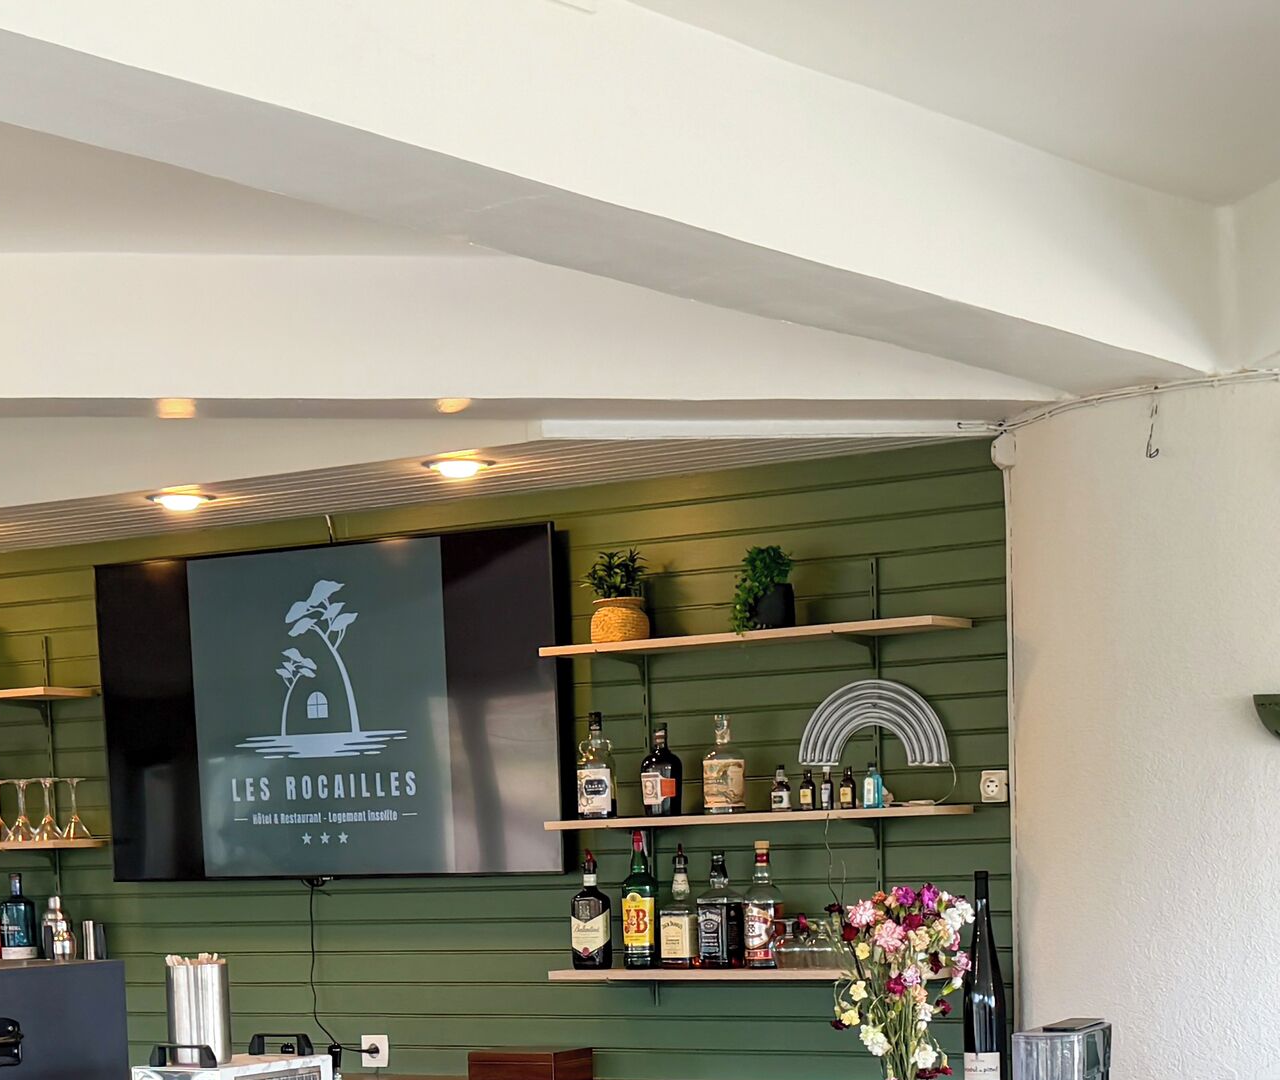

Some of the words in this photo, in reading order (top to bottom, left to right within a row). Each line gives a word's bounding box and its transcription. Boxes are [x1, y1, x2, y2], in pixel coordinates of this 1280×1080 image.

[231, 777, 270, 802] LES
[285, 770, 417, 800] ROCAILLES
[252, 812, 272, 825] Hôtel
[273, 813, 279, 824] &
[280, 812, 322, 824] Restaurant
[328, 810, 366, 824] Logement
[624, 908, 648, 934] J&B
